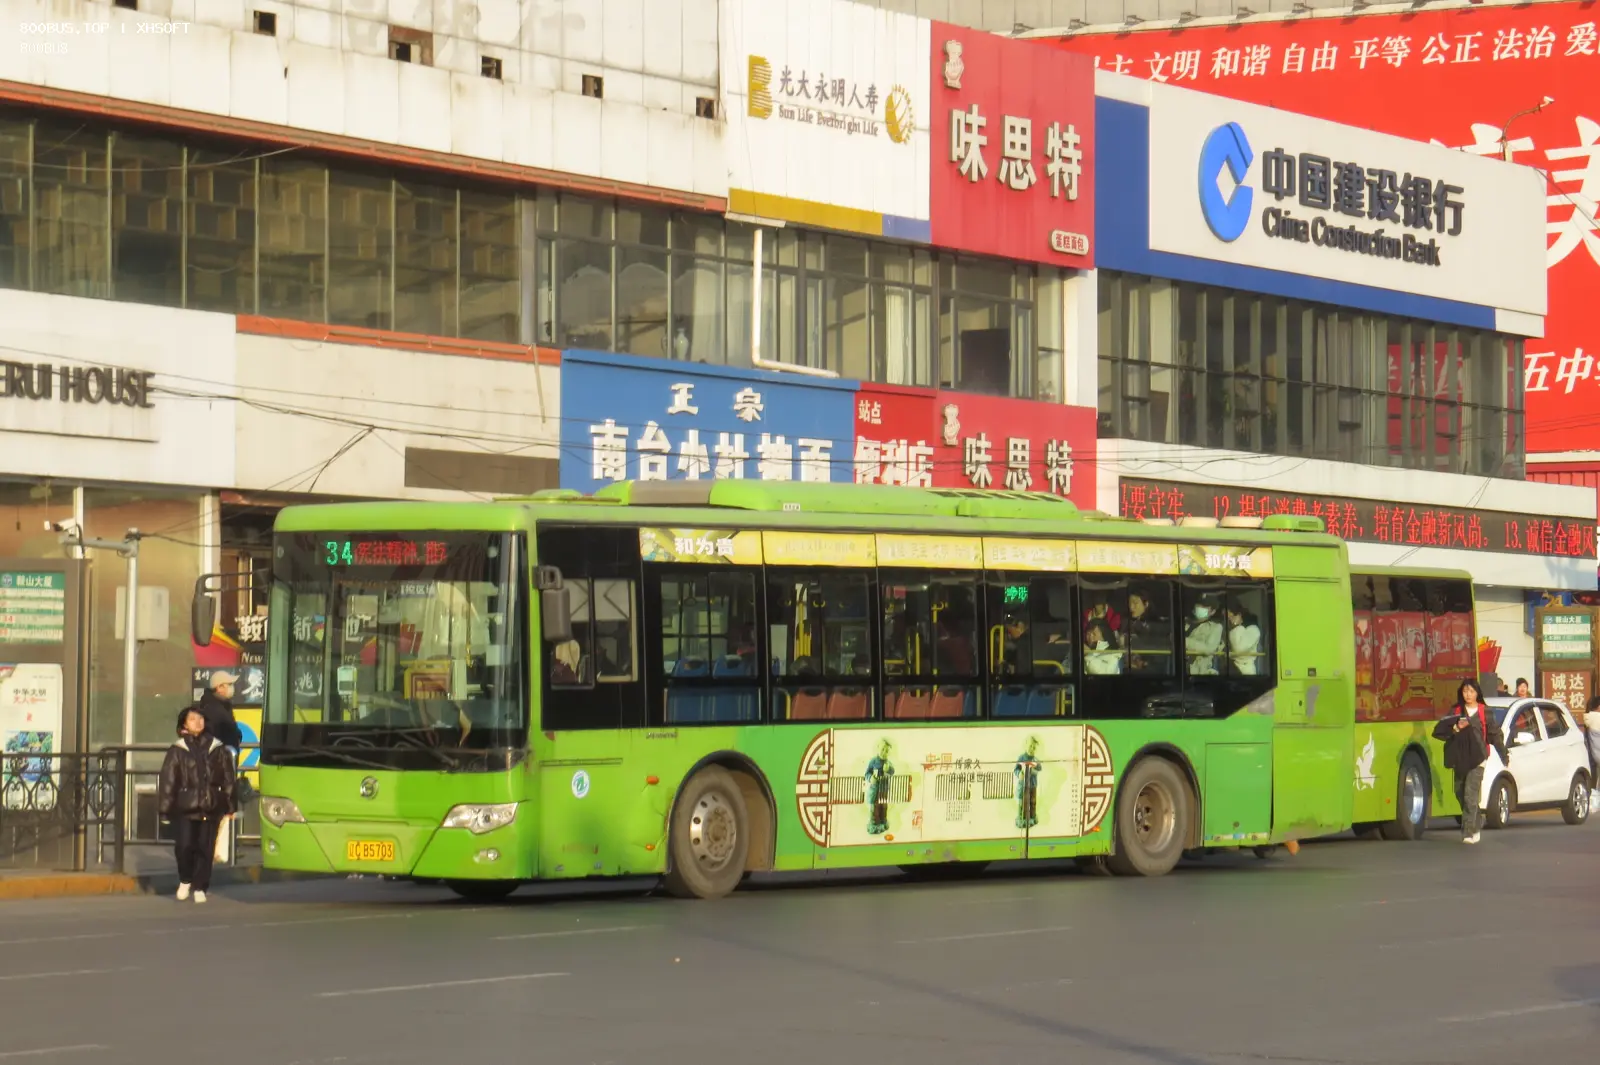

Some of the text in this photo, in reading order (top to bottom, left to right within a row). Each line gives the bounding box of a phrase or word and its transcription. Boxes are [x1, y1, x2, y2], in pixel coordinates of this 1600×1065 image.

[1143, 51, 1202, 83] 文明
[1209, 43, 1272, 79] 和谐
[1281, 40, 1339, 75] 自由
[1349, 35, 1412, 70] 平等
[1421, 31, 1484, 65] 公正
[1492, 25, 1557, 62] 法治
[1563, 21, 1600, 57] 爱
[779, 64, 879, 115] 光大永明人寿
[778, 104, 879, 137] Sun Life Everbright Life
[949, 103, 1083, 201] 味思特
[1261, 147, 1465, 237] 中国建设银行
[1262, 206, 1442, 266] China Construction Bank
[60, 366, 156, 409] HOUSE
[1524, 346, 1600, 395] 五中
[667, 382, 764, 422] 正宗
[858, 400, 882, 424] 站点
[854, 435, 934, 488] 便利店
[963, 432, 1074, 495] 味思特
[326, 541, 353, 566] 34
[674, 536, 735, 556] 和为贵
[1205, 553, 1252, 570] 和为贵
[1551, 673, 1585, 691] 诚达
[1551, 691, 1586, 709] 学校
